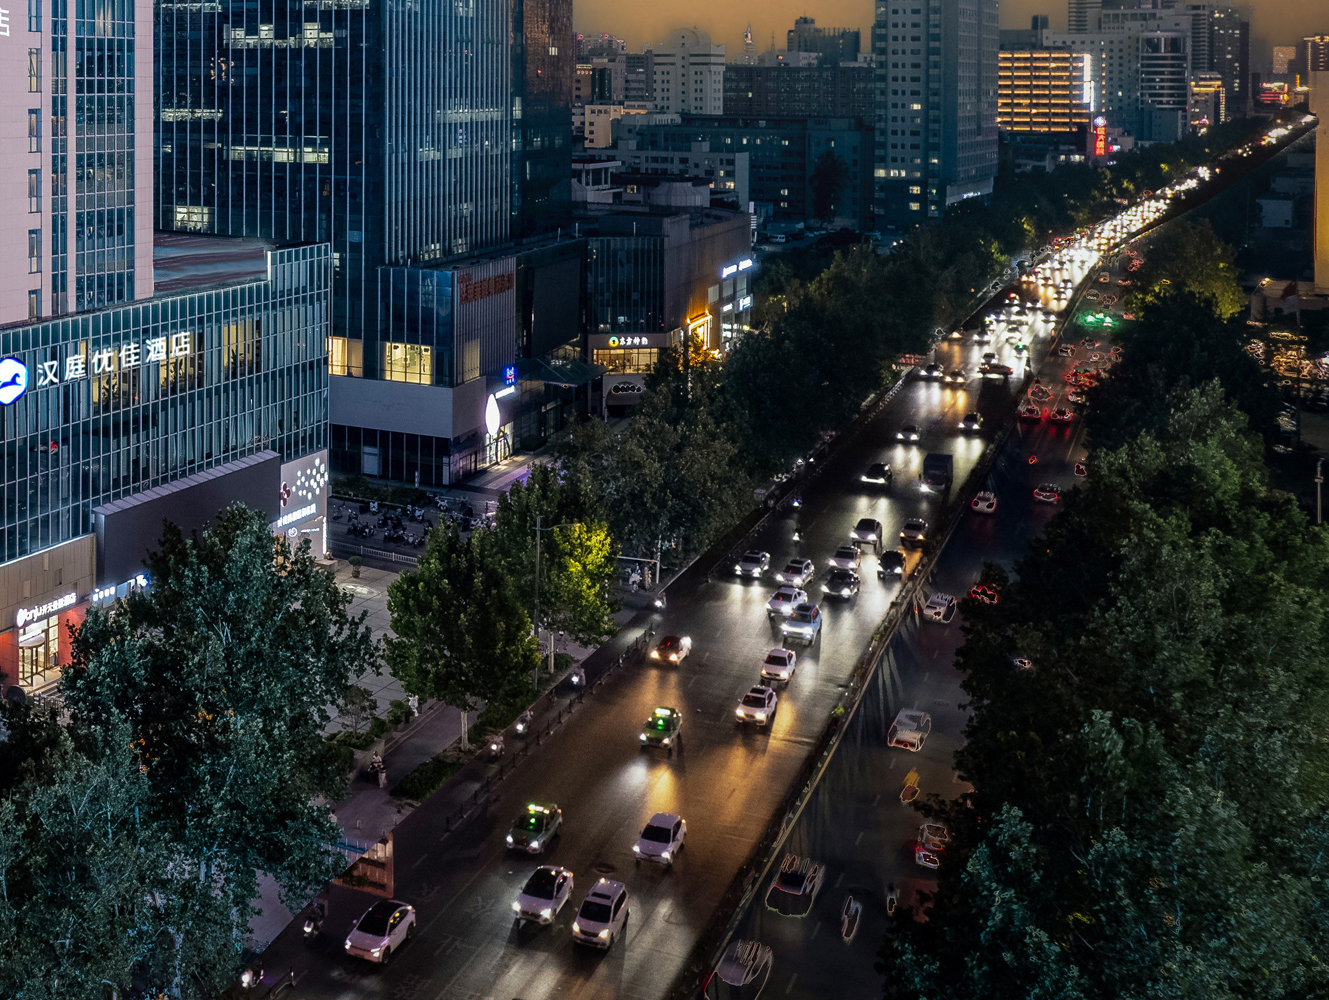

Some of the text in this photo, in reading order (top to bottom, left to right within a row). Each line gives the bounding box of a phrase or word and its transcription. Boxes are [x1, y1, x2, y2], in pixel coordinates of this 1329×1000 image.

[36, 331, 192, 387] 汉庭优佳酒店
